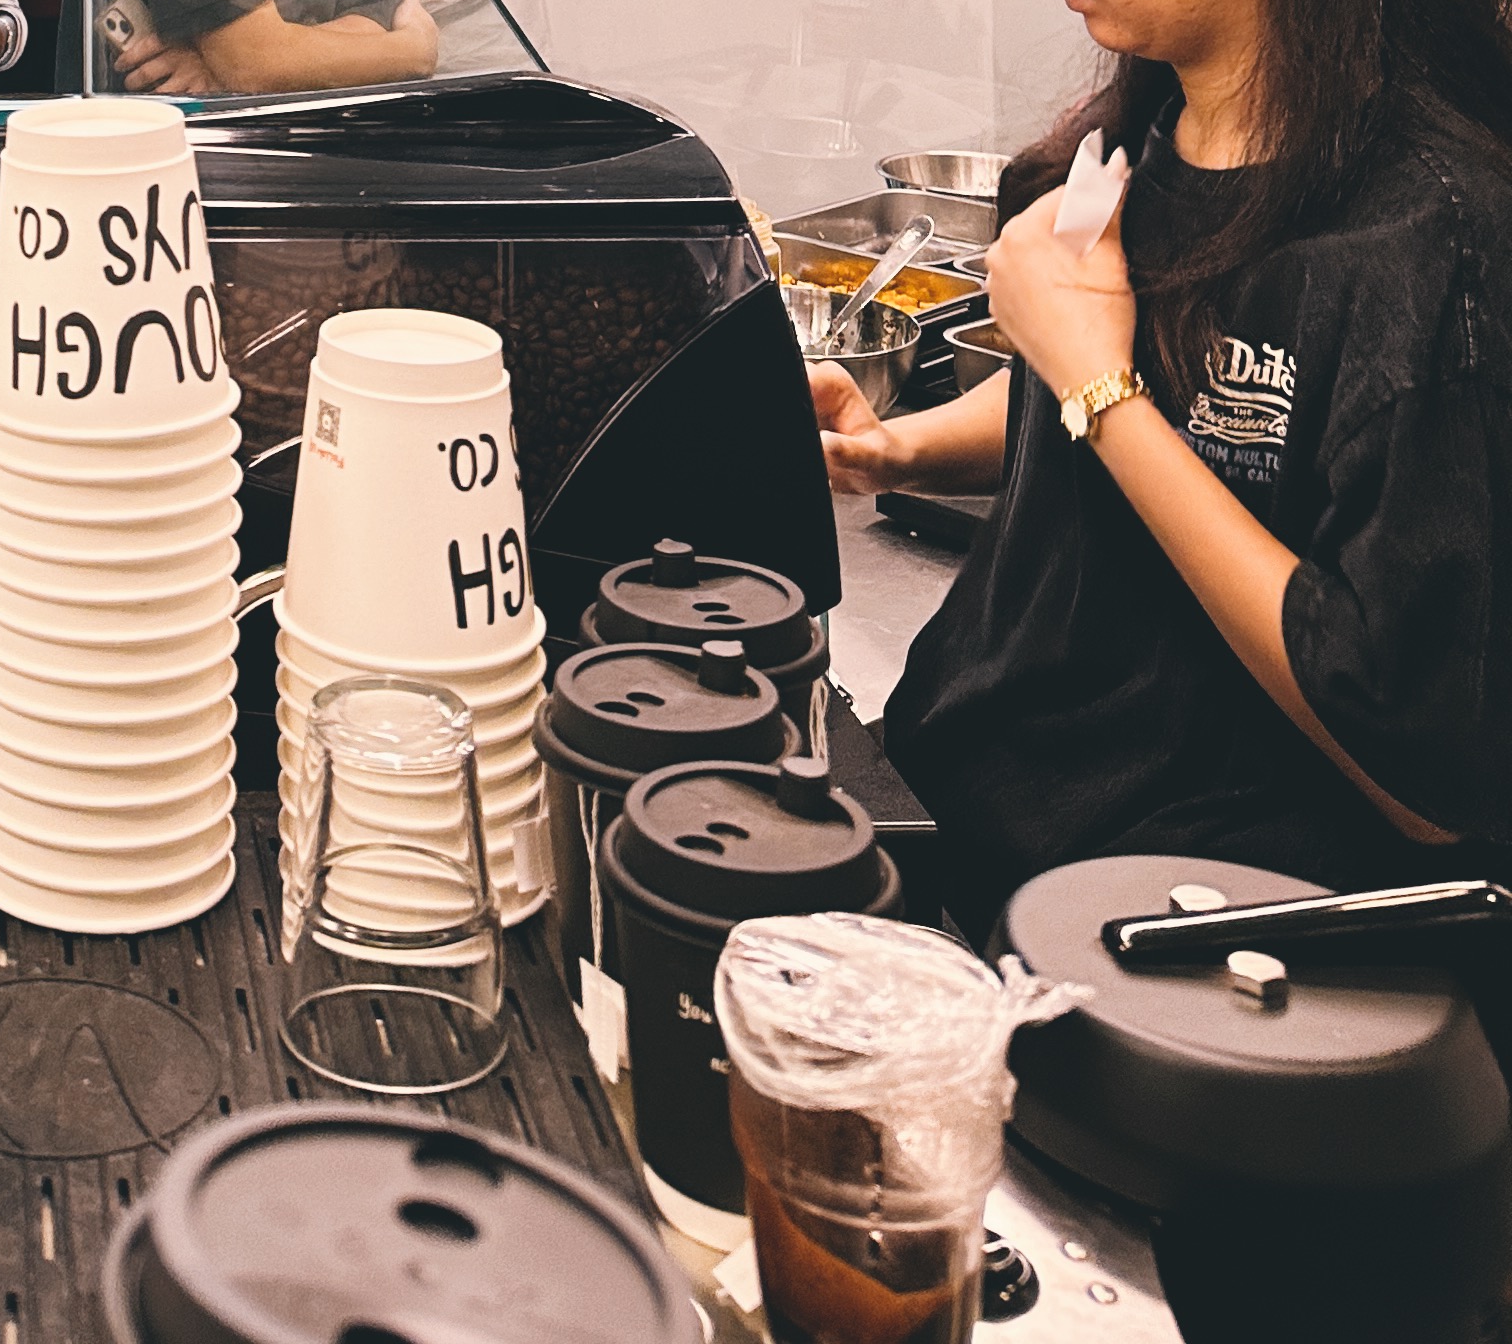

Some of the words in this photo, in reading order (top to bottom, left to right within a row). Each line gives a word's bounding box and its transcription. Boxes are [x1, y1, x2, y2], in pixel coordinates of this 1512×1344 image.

[12, 284, 226, 401] OUGH
[436, 432, 500, 493] CO.
[448, 527, 531, 631] GH
